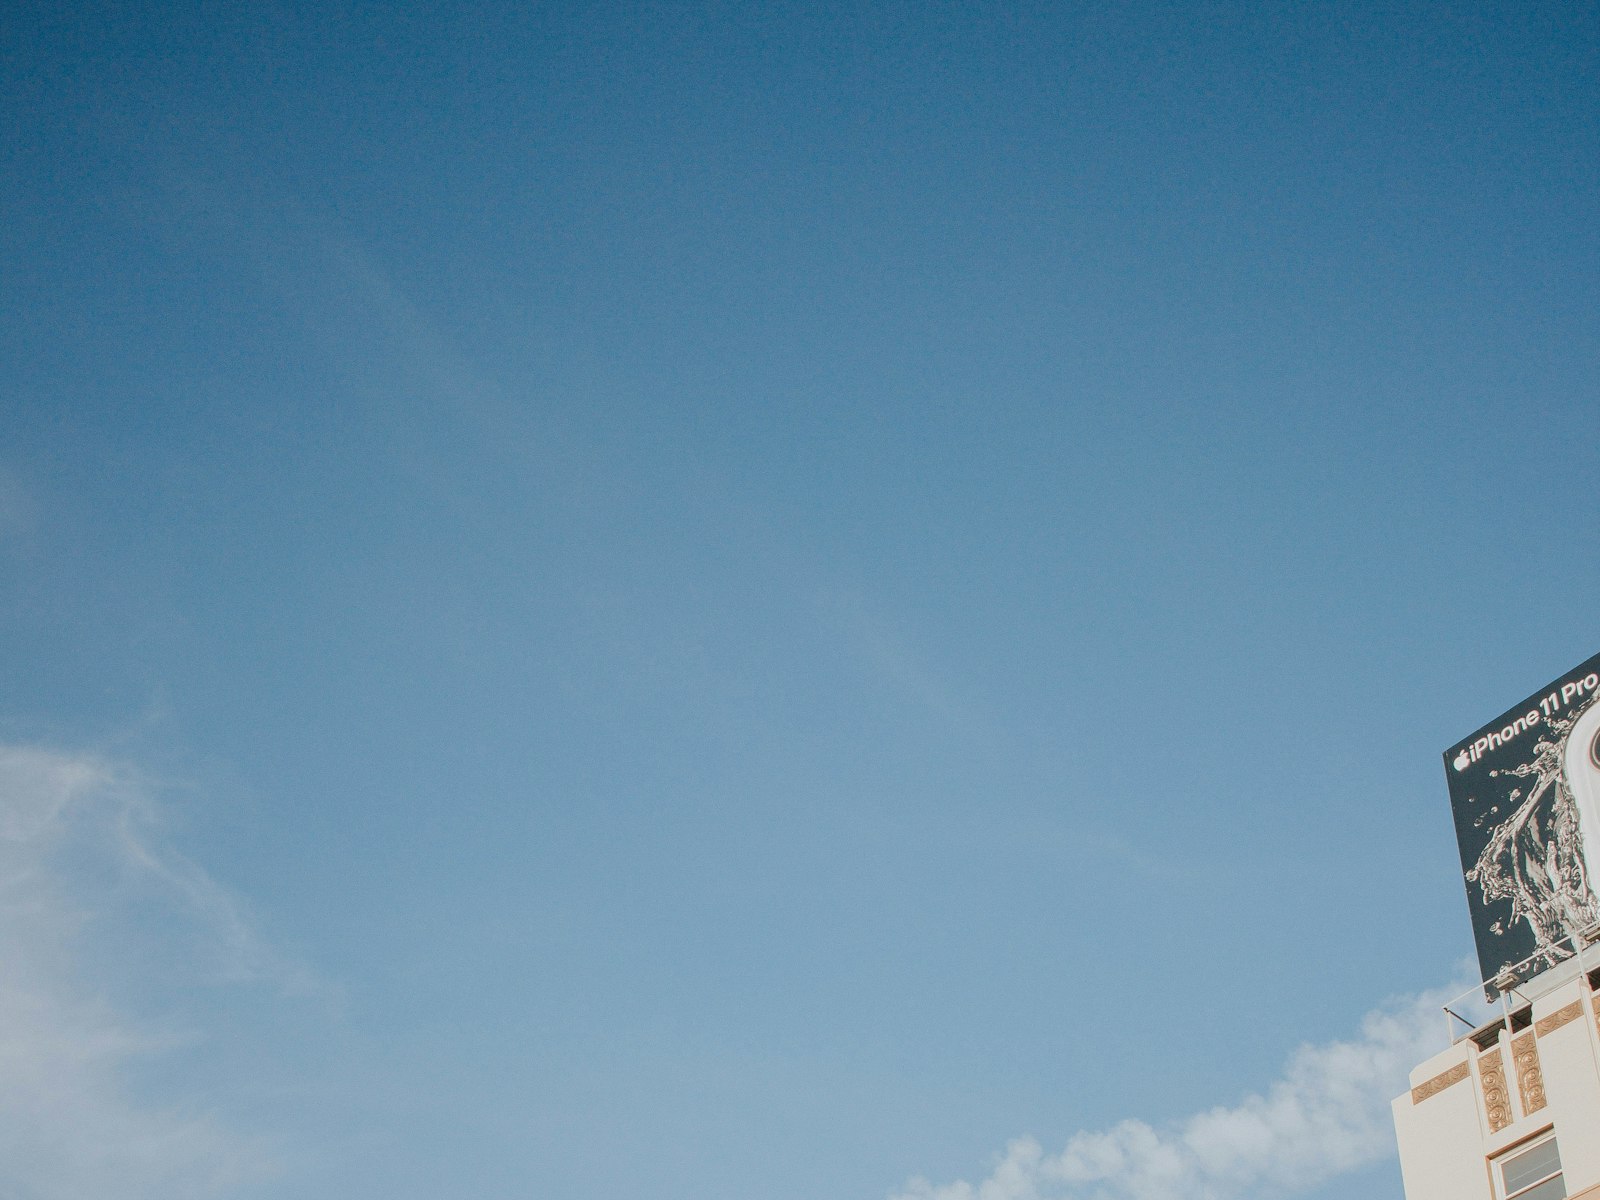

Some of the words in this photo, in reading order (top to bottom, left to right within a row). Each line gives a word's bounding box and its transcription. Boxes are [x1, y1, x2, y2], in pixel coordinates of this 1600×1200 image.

[1469, 709, 1540, 763] iPhone
[1540, 692, 1559, 716] 11
[1561, 673, 1599, 705] Pro
